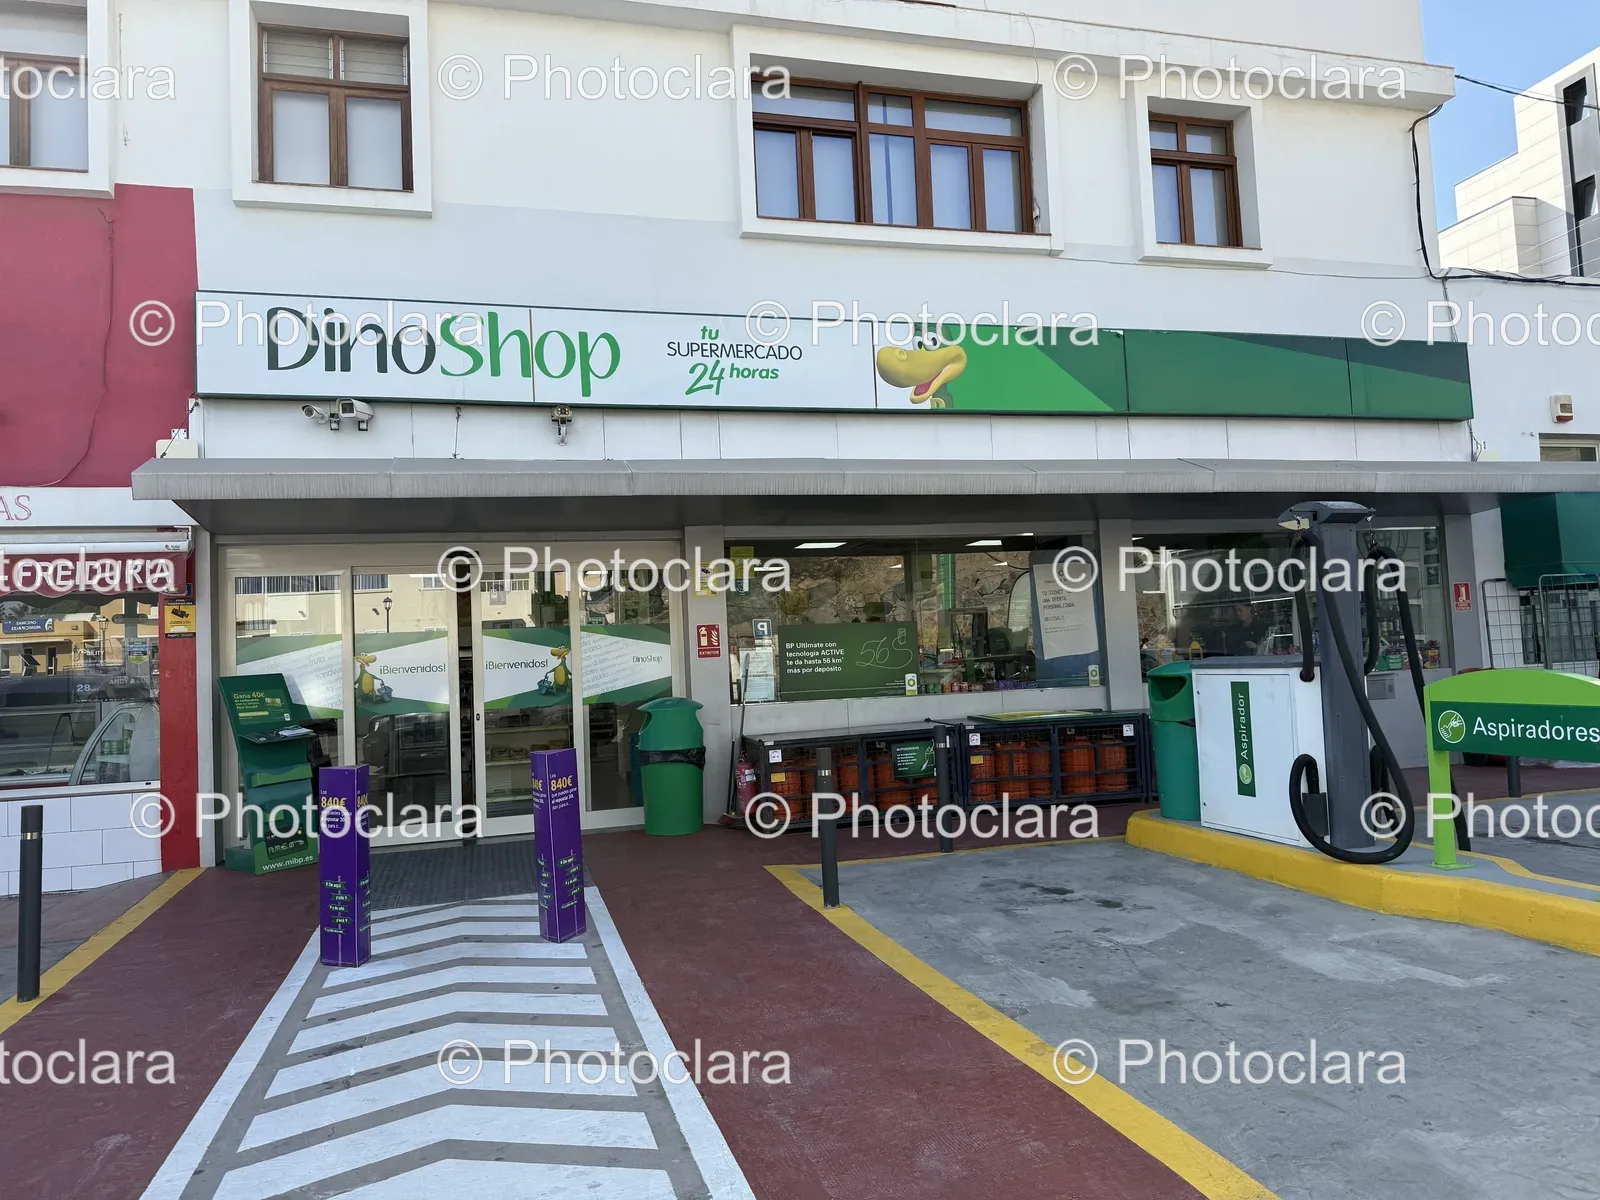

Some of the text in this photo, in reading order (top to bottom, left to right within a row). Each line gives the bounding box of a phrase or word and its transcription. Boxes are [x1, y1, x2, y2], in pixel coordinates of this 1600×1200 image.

[701, 326, 719, 340] tu
[267, 305, 621, 398] DinoShop
[667, 342, 803, 360] SUPERMERCADO
[685, 359, 779, 395] 24 horas
[485, 659, 548, 670] ¡Bienvenidos!
[632, 655, 663, 664] DinoShop
[379, 663, 446, 675] ¡Bienvenidos!
[815, 666, 842, 674] depósito
[76, 684, 91, 692] 28
[1238, 693, 1248, 759] Aspirador
[1473, 716, 1600, 744] Aspiradores
[551, 775, 573, 791] 840€
[321, 796, 347, 808] 840€
[262, 855, 314, 870] www.mibp.es
